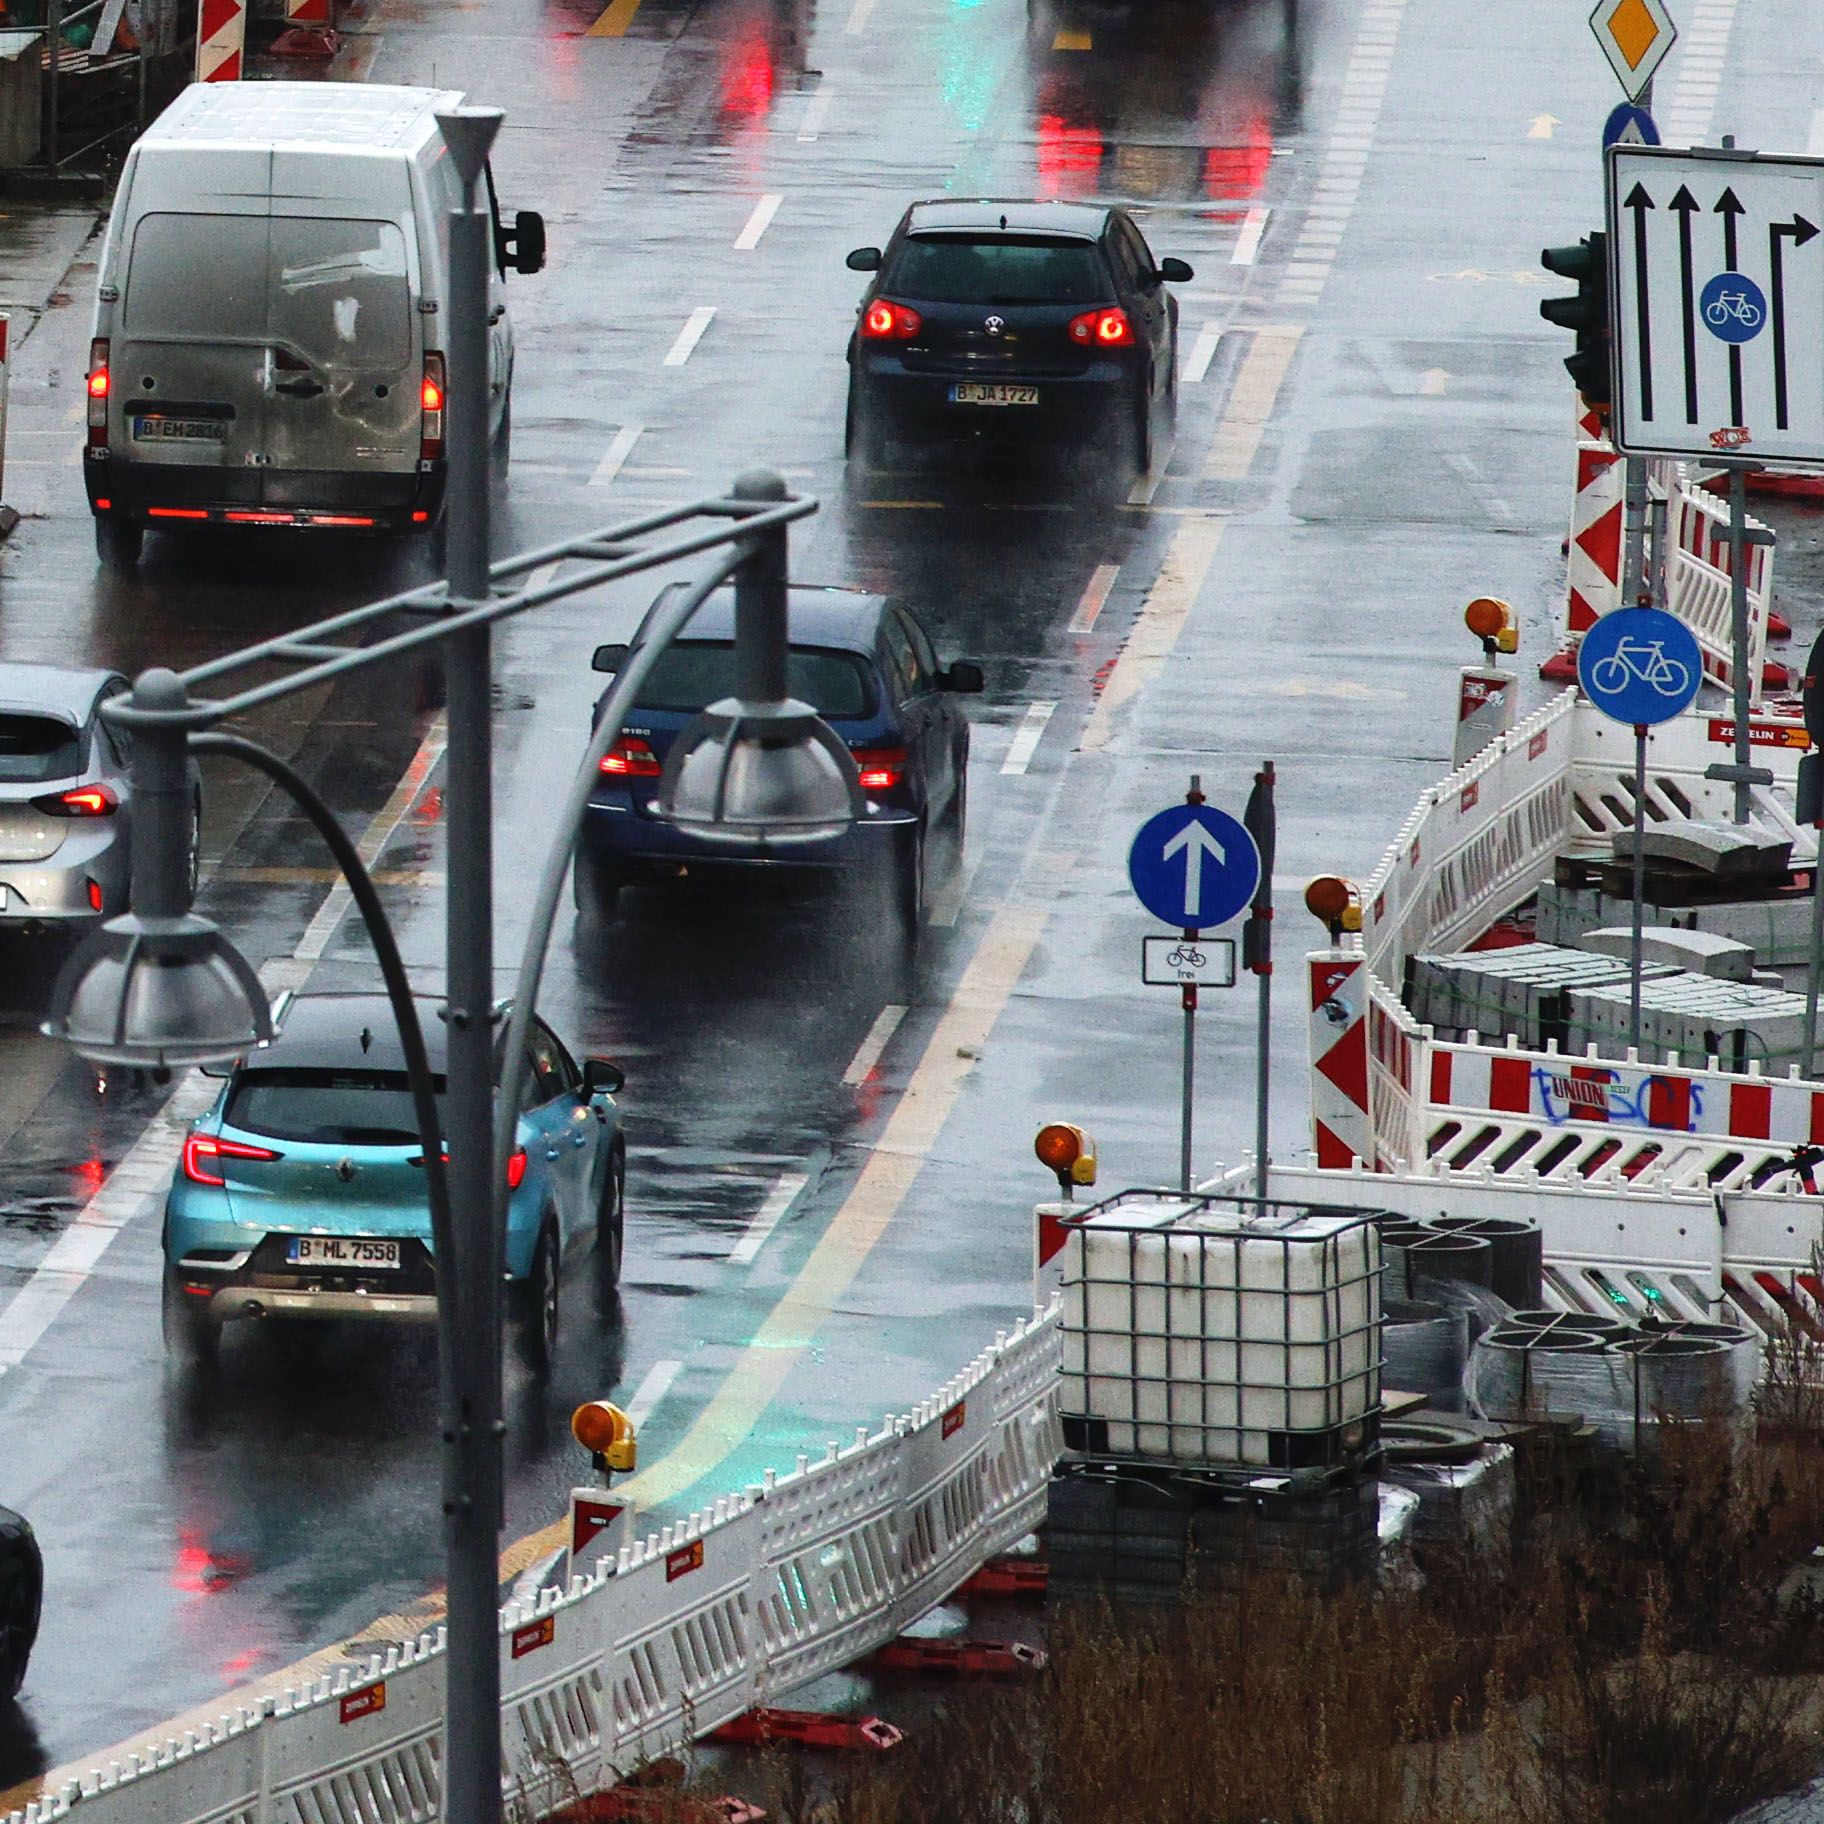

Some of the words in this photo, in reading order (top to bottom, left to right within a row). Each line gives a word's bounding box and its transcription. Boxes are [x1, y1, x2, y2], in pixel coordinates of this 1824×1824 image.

[955, 386, 965, 403] B
[999, 386, 1039, 403] 1727
[1176, 968, 1196, 979] frei
[1552, 1075, 1608, 1108] UNION
[299, 1238, 312, 1257] B
[322, 1240, 347, 1259] ML
[351, 1242, 397, 1262] 7558
